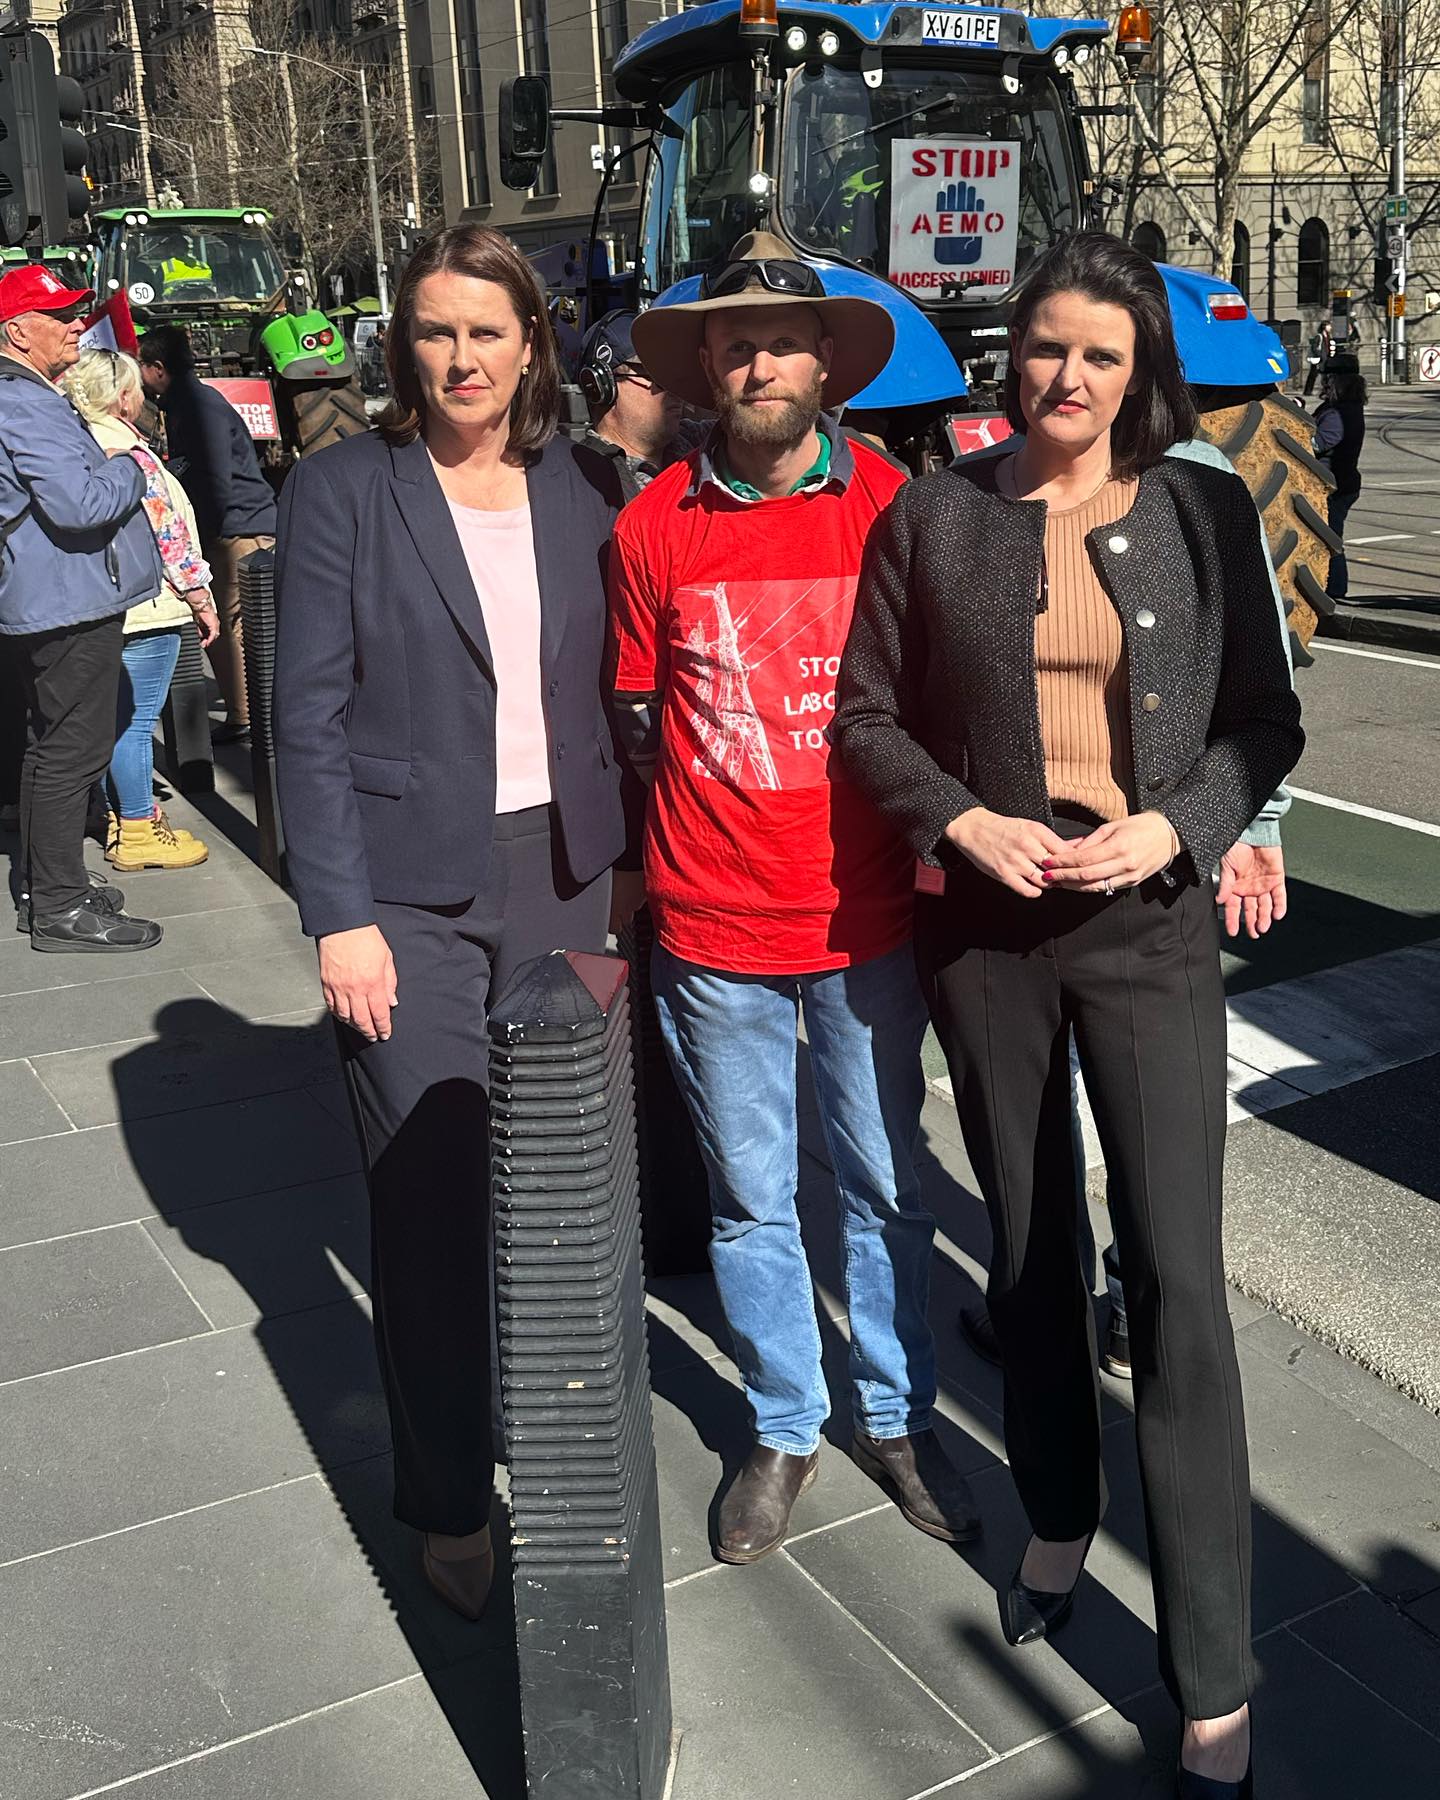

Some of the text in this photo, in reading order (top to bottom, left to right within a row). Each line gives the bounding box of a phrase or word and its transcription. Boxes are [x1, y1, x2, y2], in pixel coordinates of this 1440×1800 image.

[911, 148, 1010, 178] STOP
[911, 212, 1004, 235] AEMO
[899, 269, 1010, 288] ACCESS DENIED
[134, 286, 149, 300] 50
[787, 725, 827, 751] TO
